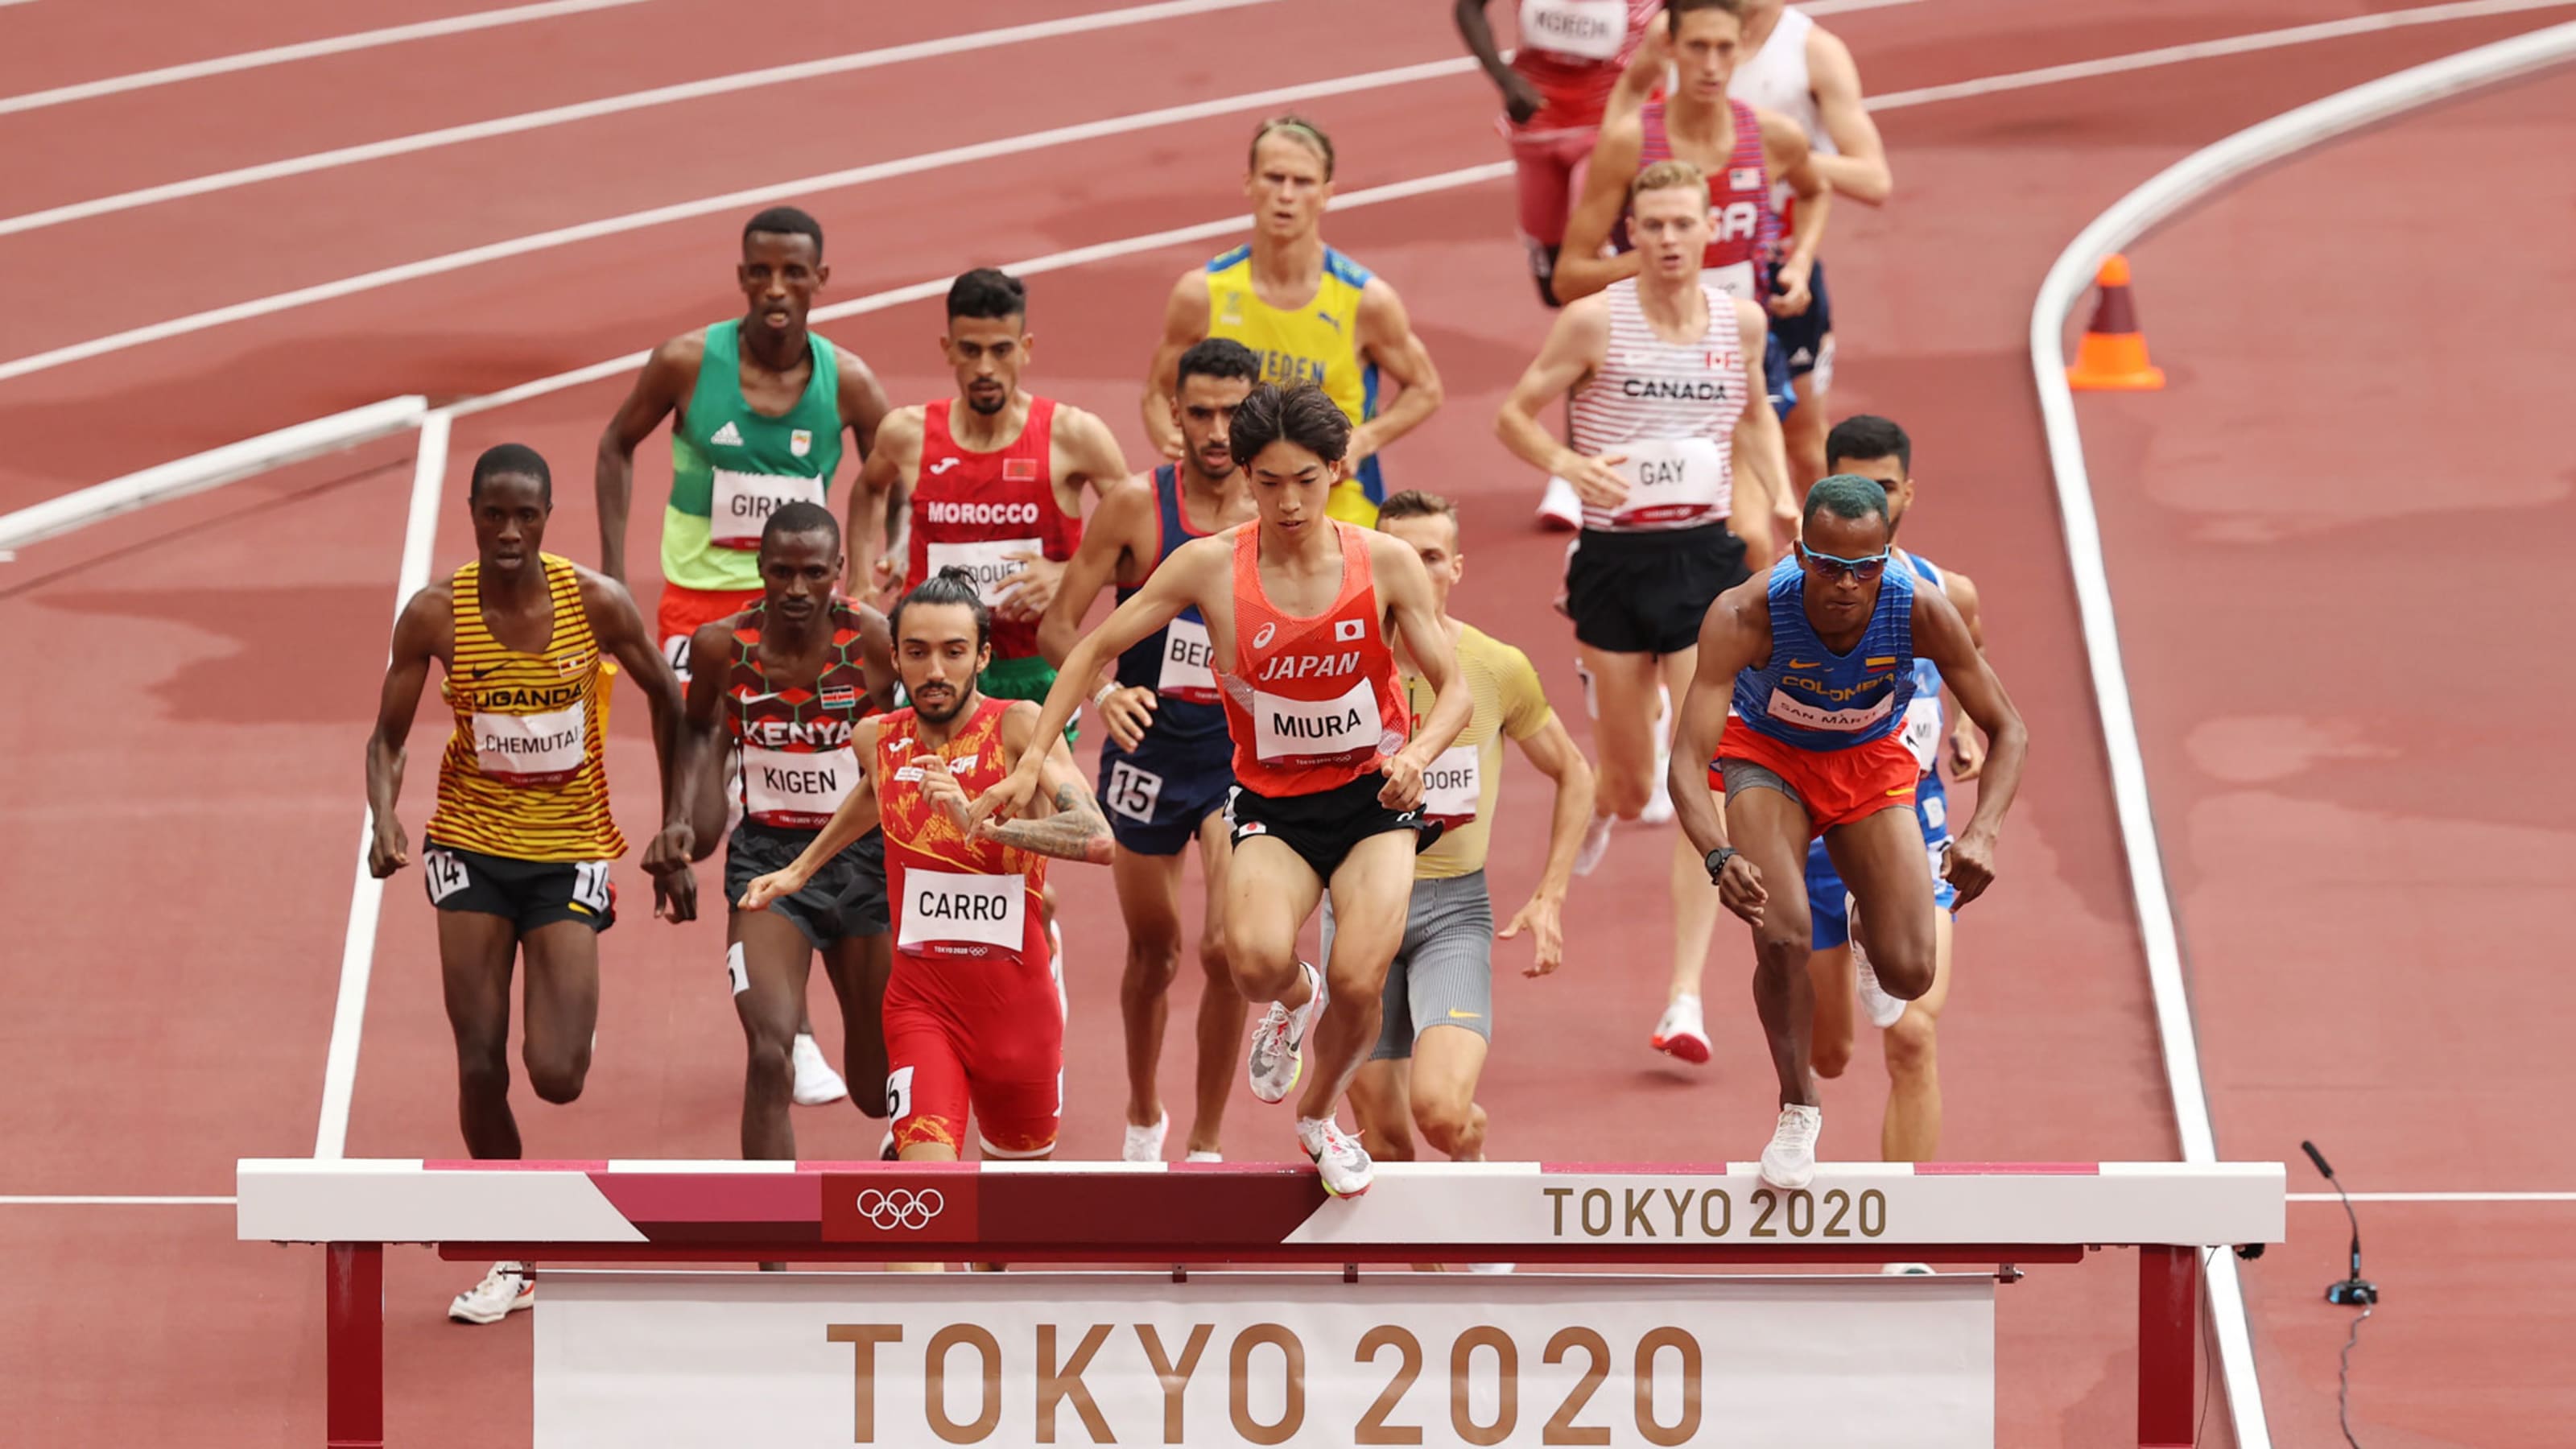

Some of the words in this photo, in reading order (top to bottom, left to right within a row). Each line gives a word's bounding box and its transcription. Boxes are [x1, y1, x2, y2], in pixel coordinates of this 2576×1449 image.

[1253, 349, 1327, 383] EDEN
[1623, 379, 1728, 401] CANADA
[1639, 458, 1686, 485] GAY
[731, 493, 810, 519] GIR
[928, 501, 1038, 524] MOROCCO
[1258, 650, 1360, 681] JAPAN
[473, 683, 583, 708] UGANDA
[1273, 708, 1362, 738] MIURA
[1781, 702, 1814, 720] SAN
[485, 725, 579, 754] CHEMUTAI
[741, 720, 853, 747] KENYA
[764, 767, 837, 795] KIGEN
[1116, 770, 1152, 814] 15
[427, 854, 460, 894] 14
[919, 891, 1007, 921] CARRO
[1543, 1187, 1731, 1236] TOKYO
[1749, 1188, 1886, 1237] 2020
[827, 1323, 1305, 1443] TOKYO
[1354, 1325, 1703, 1446] 2020
